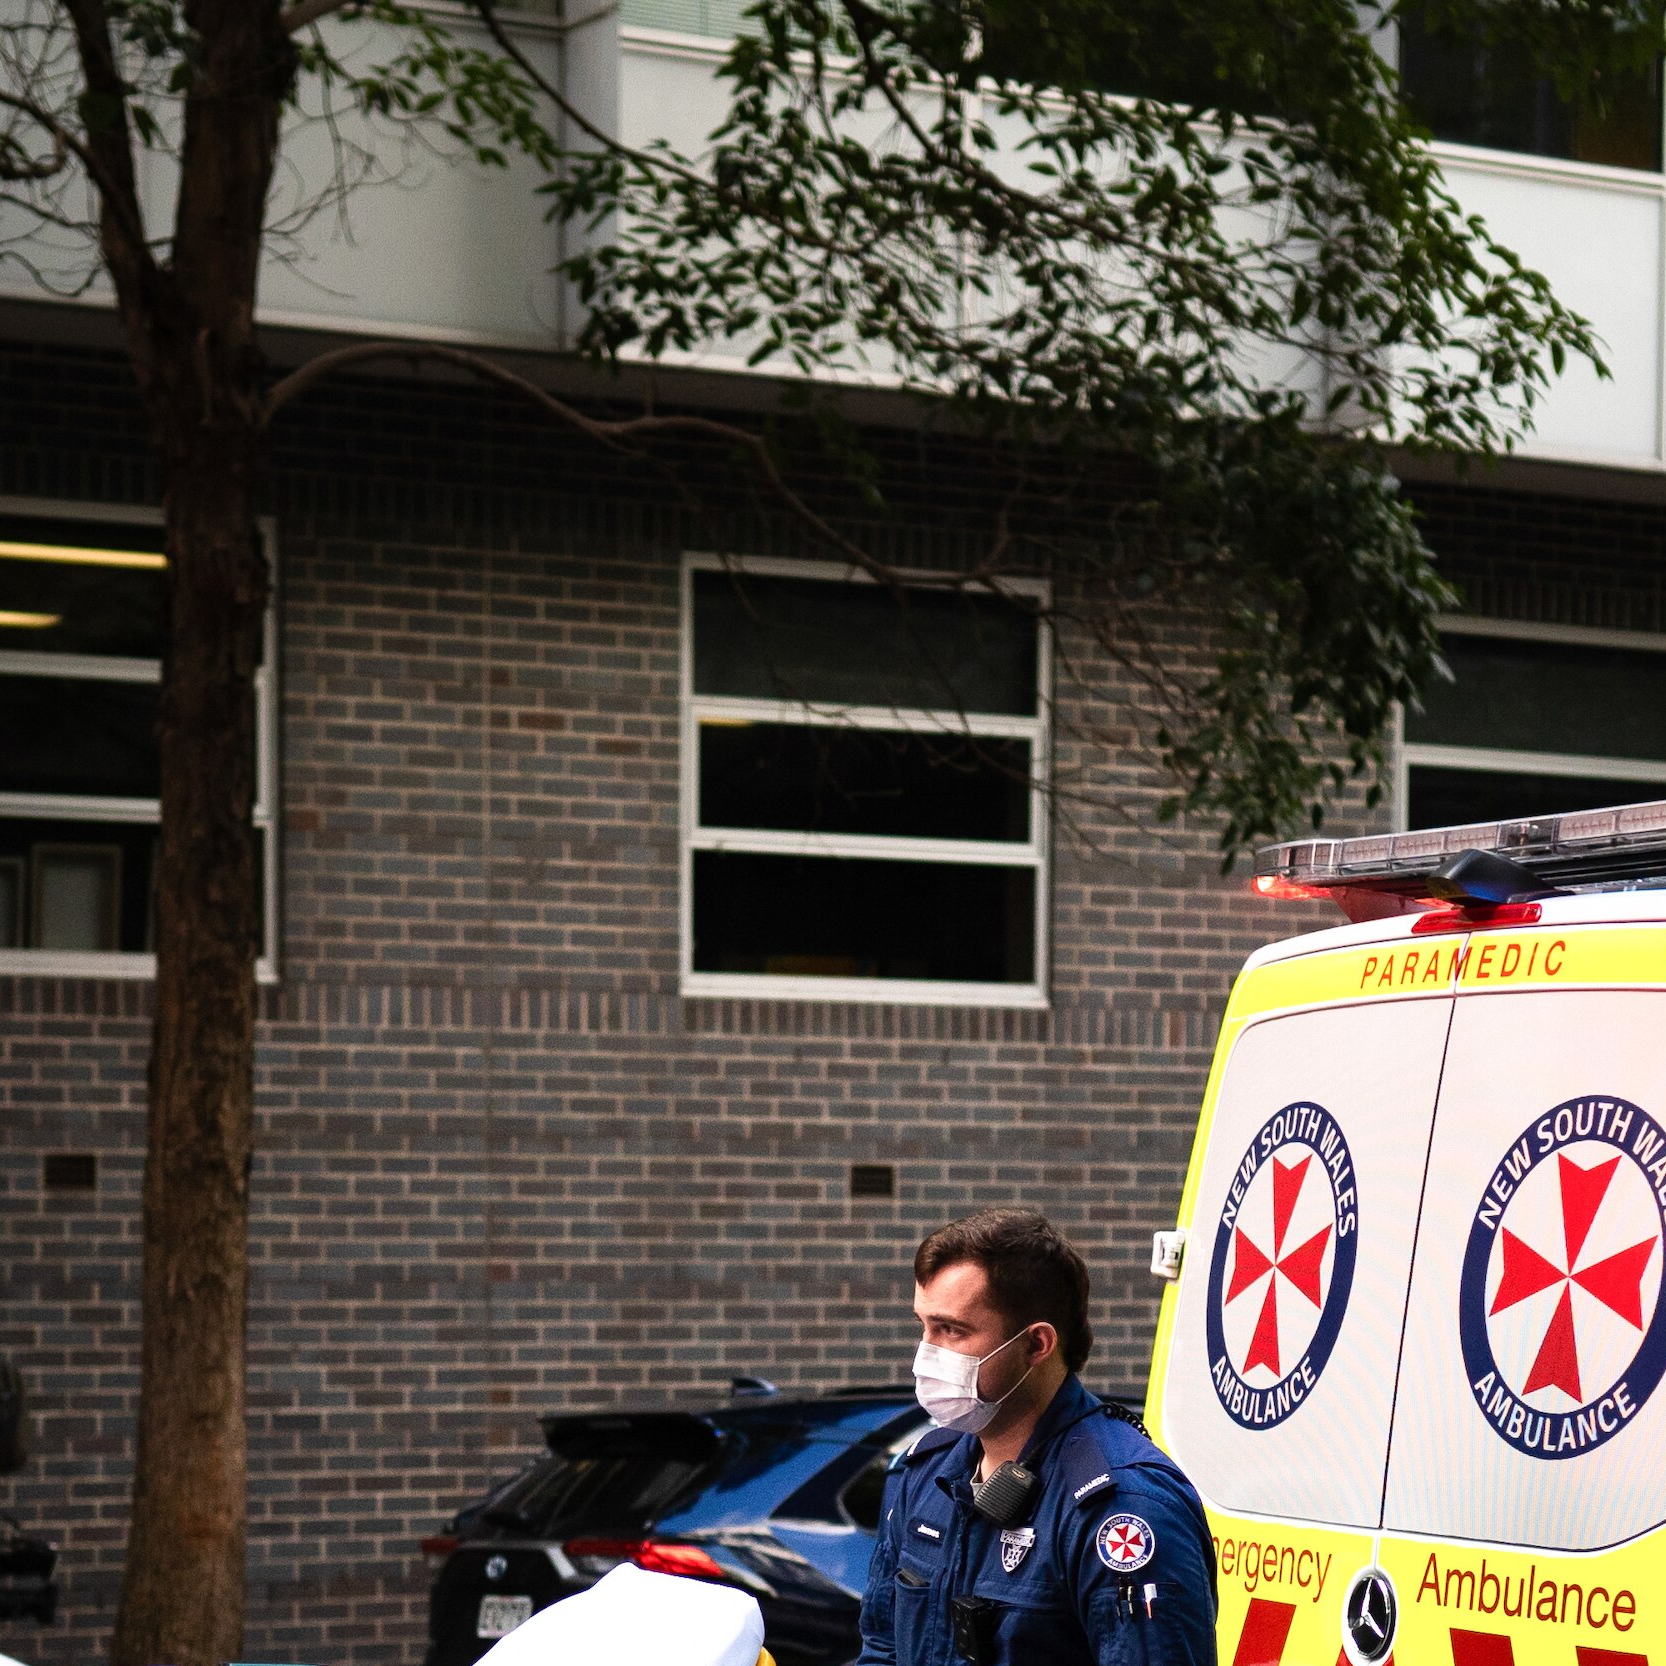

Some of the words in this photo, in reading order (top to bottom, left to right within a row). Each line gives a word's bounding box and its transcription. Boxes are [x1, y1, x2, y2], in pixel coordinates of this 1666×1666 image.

[1360, 940, 1566, 989] PARAMEDIC
[1222, 1145, 1257, 1229] NEW
[1261, 1107, 1322, 1157] SOUTH
[1320, 1121, 1355, 1237] WALES
[1478, 1138, 1532, 1230] NEW
[1537, 1101, 1634, 1153] SOUTH
[1212, 1356, 1315, 1423] AMBULANCE
[1474, 1371, 1637, 1452] AMBULANCE
[1074, 1473, 1110, 1499] PARAMEDIC
[1107, 1517, 1130, 1528] SOUTH
[1132, 1519, 1150, 1539] WALES
[1108, 1554, 1149, 1570] AMBULANCE
[1213, 1536, 1332, 1603] ergency
[1416, 1553, 1635, 1632] Ambulance
